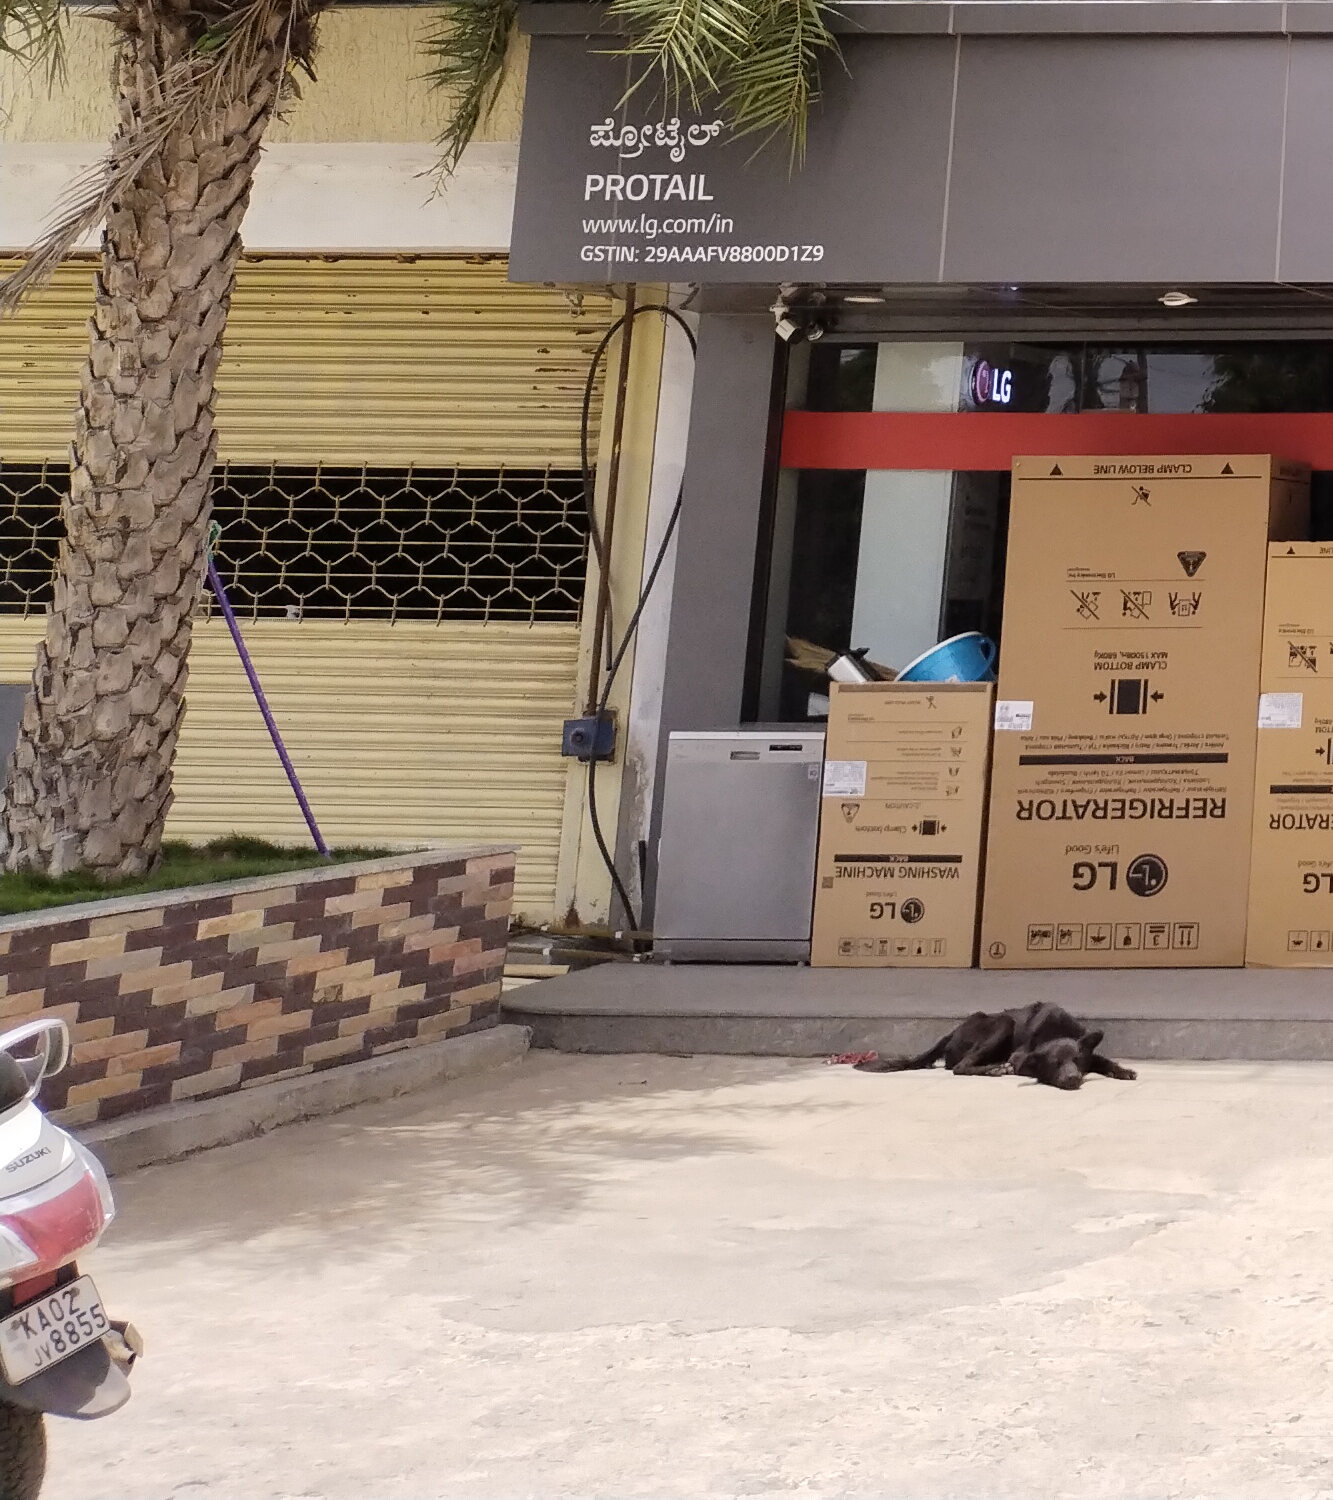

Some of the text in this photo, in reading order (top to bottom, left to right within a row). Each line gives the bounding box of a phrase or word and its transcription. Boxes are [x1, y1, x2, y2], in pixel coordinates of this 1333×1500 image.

[583, 173, 715, 202] PROTAIL
[581, 212, 735, 239] www.lg.com/in
[580, 244, 825, 263] GSTIN: 29AAAFV8800D1Z9
[992, 367, 1013, 404] LG
[1093, 463, 1193, 475] CLAMP BELOW LINE
[1093, 661, 1168, 671] CLAMP BOTTOM
[1015, 797, 1227, 821] REFRIGERATOR
[1064, 844, 1120, 856] Life's Good
[835, 866, 960, 880] WASHING MACHINE
[1072, 861, 1119, 891] LG
[869, 902, 897, 920] LG
[5, 1146, 53, 1174] SUZUKI
[19, 1291, 82, 1340] KA02
[49, 1302, 107, 1354] 8855
